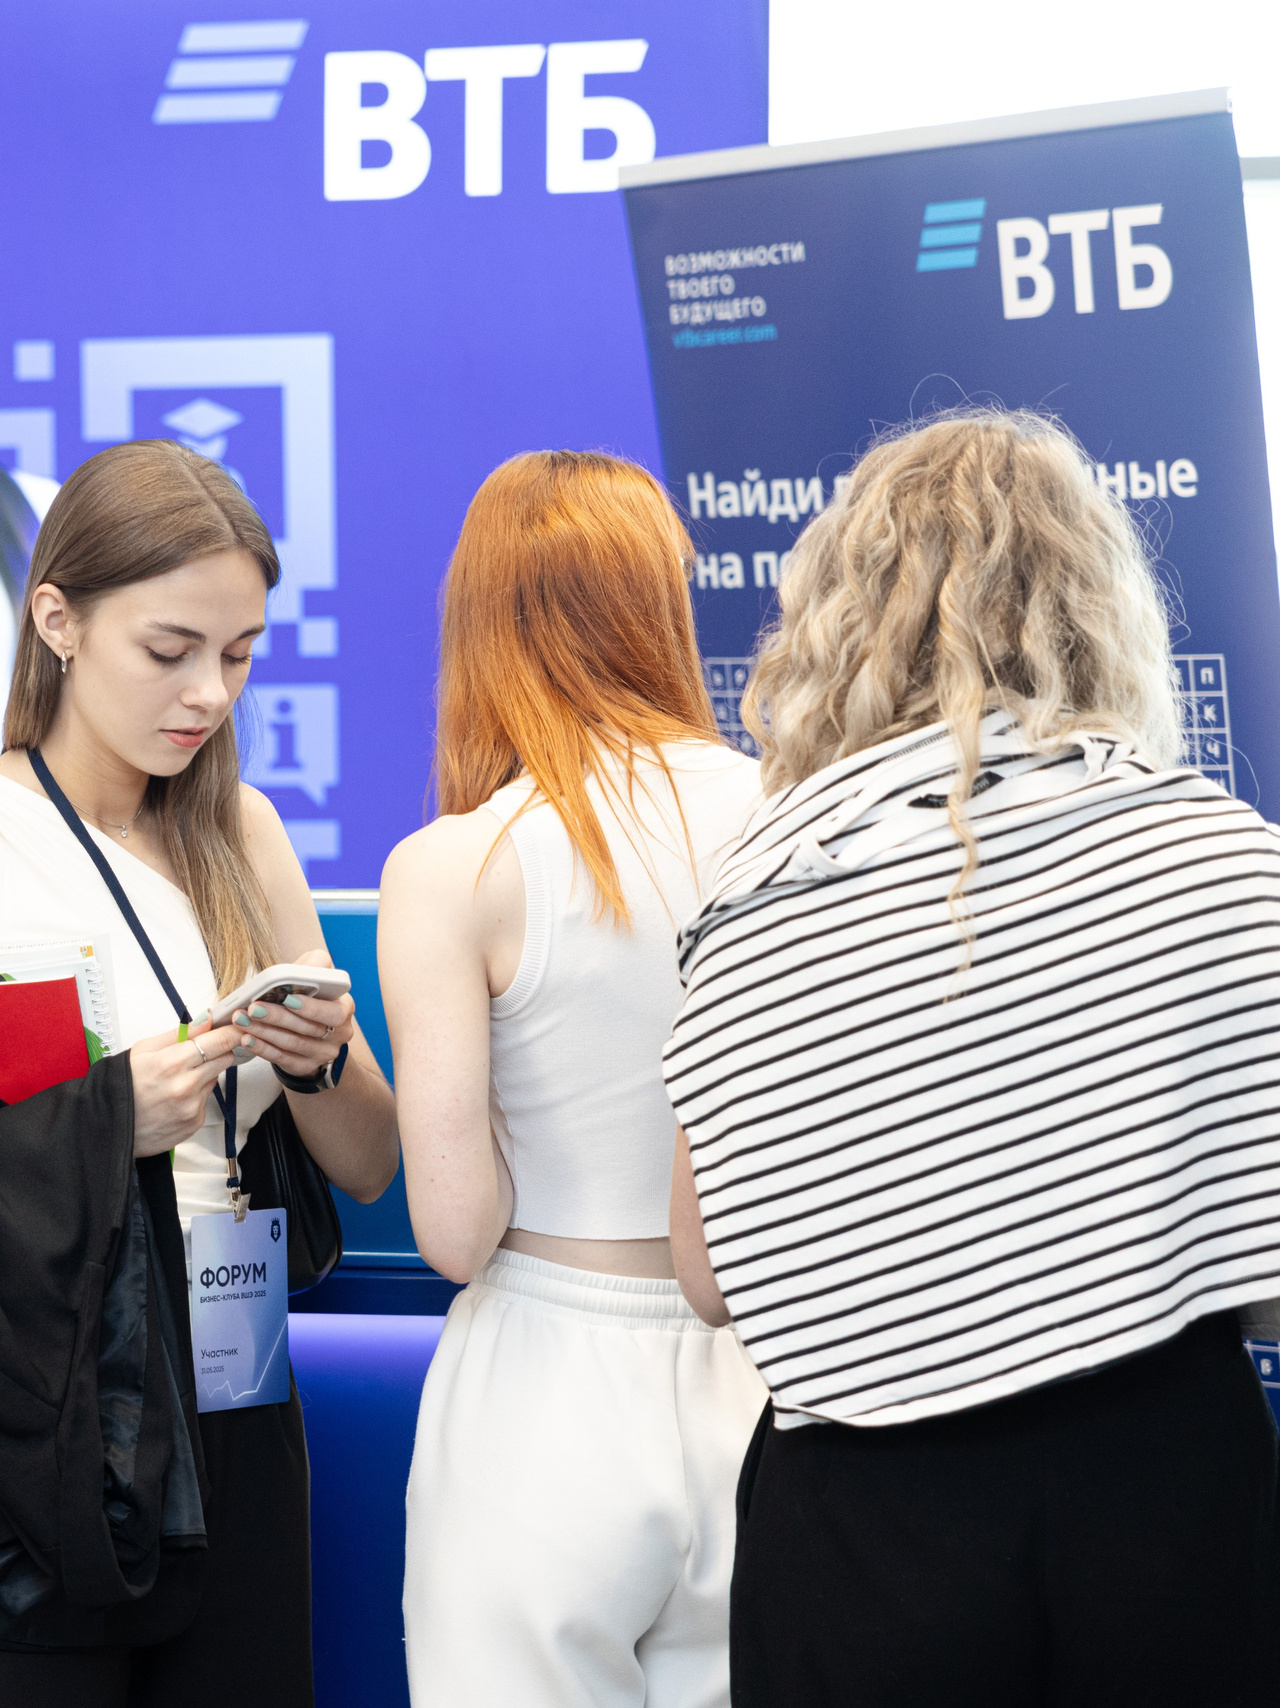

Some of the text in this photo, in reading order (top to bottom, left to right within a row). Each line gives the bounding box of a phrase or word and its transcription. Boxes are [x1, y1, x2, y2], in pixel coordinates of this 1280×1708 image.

[323, 38, 656, 202] ВТБ
[664, 240, 806, 276] ВОЗМОЖНОСТИ
[996, 202, 1175, 321] ВТБ
[666, 273, 736, 300] ТВОЕГО
[668, 295, 768, 326] БУДУЩЕГО
[686, 468, 824, 525] Найди
[695, 552, 746, 590] на
[200, 1261, 267, 1289] ФОРУМ
[200, 1290, 267, 1304] БИЗНЕС-КЛУБА ВШЭ 2025
[200, 1348, 239, 1359] Участник
